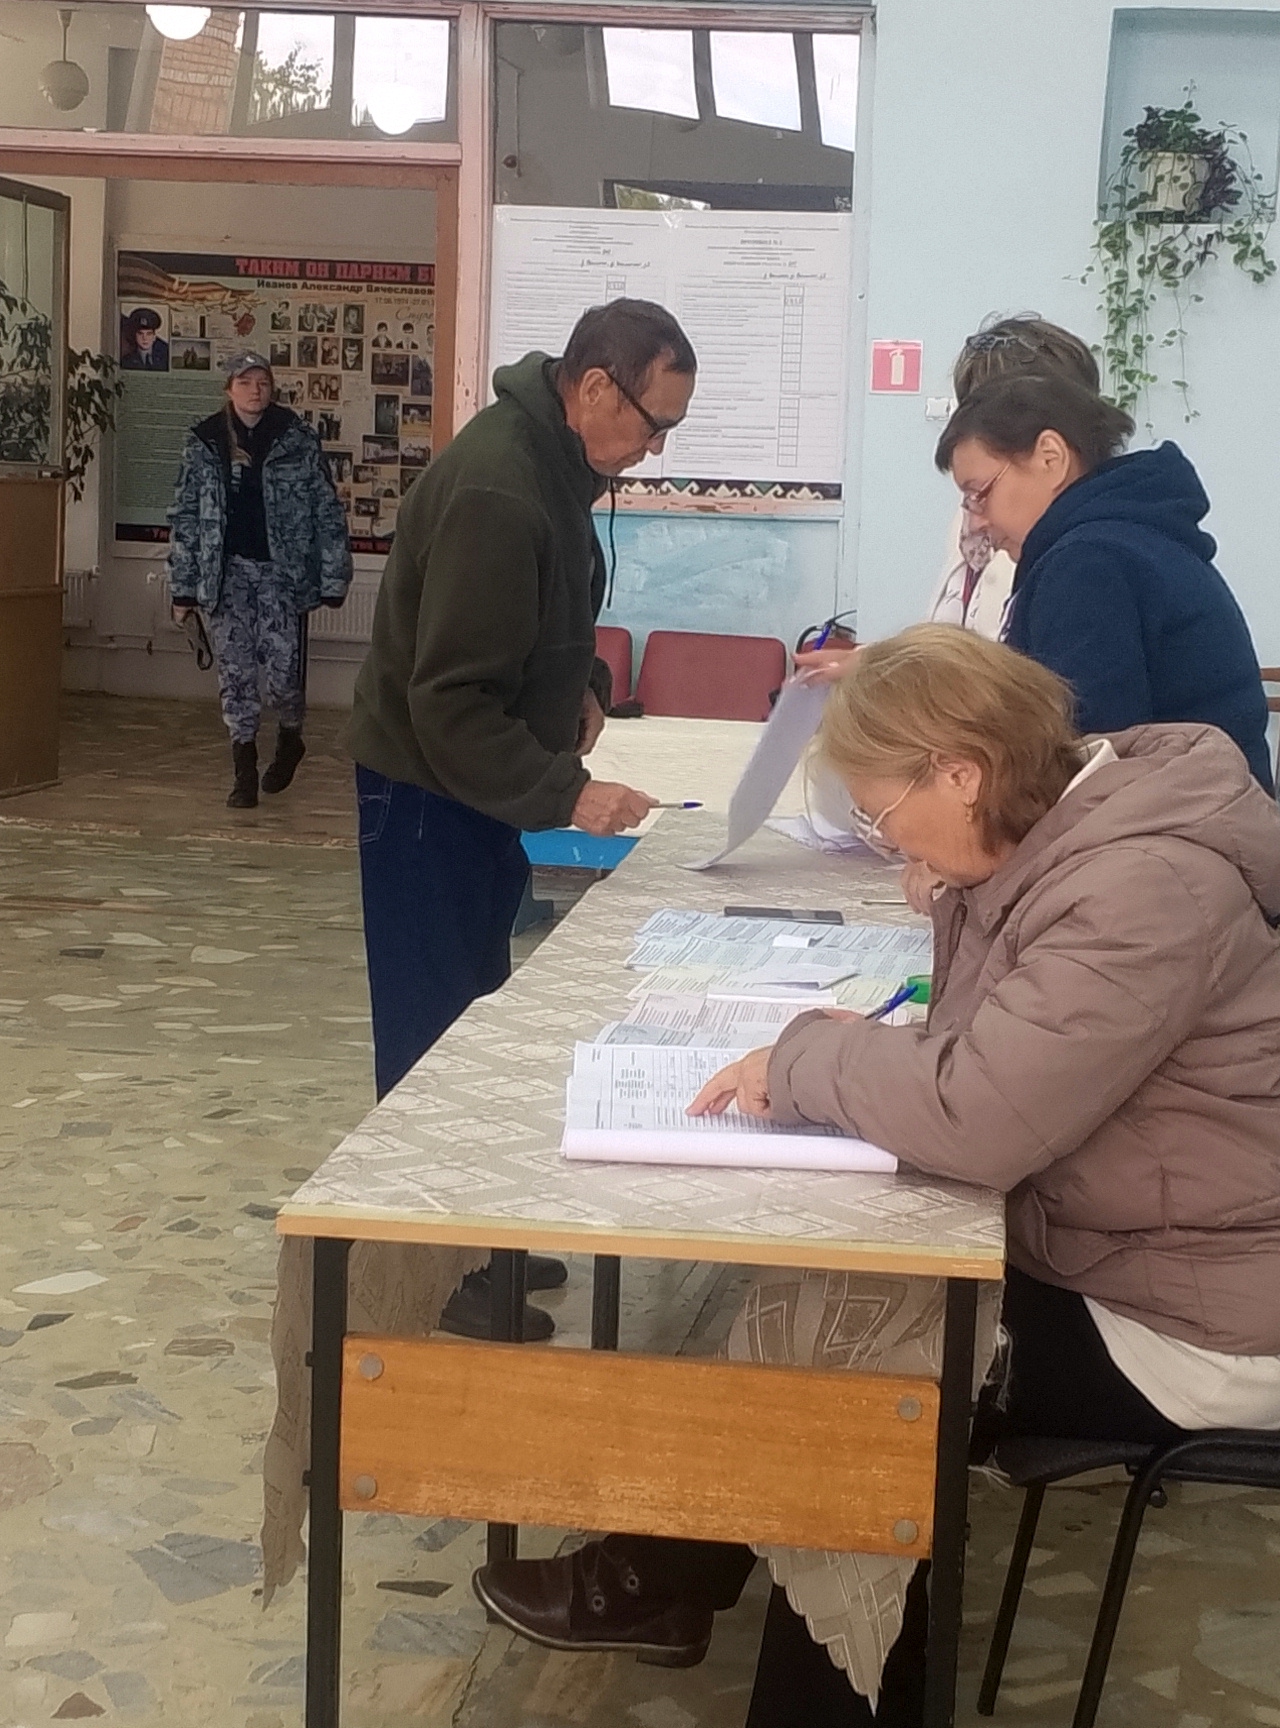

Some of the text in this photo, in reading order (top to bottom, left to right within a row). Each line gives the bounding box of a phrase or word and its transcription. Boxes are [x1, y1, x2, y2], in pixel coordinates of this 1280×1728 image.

[234, 258, 300, 277] ТАКИМ
[305, 261, 329, 279] ОН
[335, 262, 412, 283] ПАРНЕМ
[257, 279, 298, 290] Иванов
[301, 281, 363, 294] Александр
